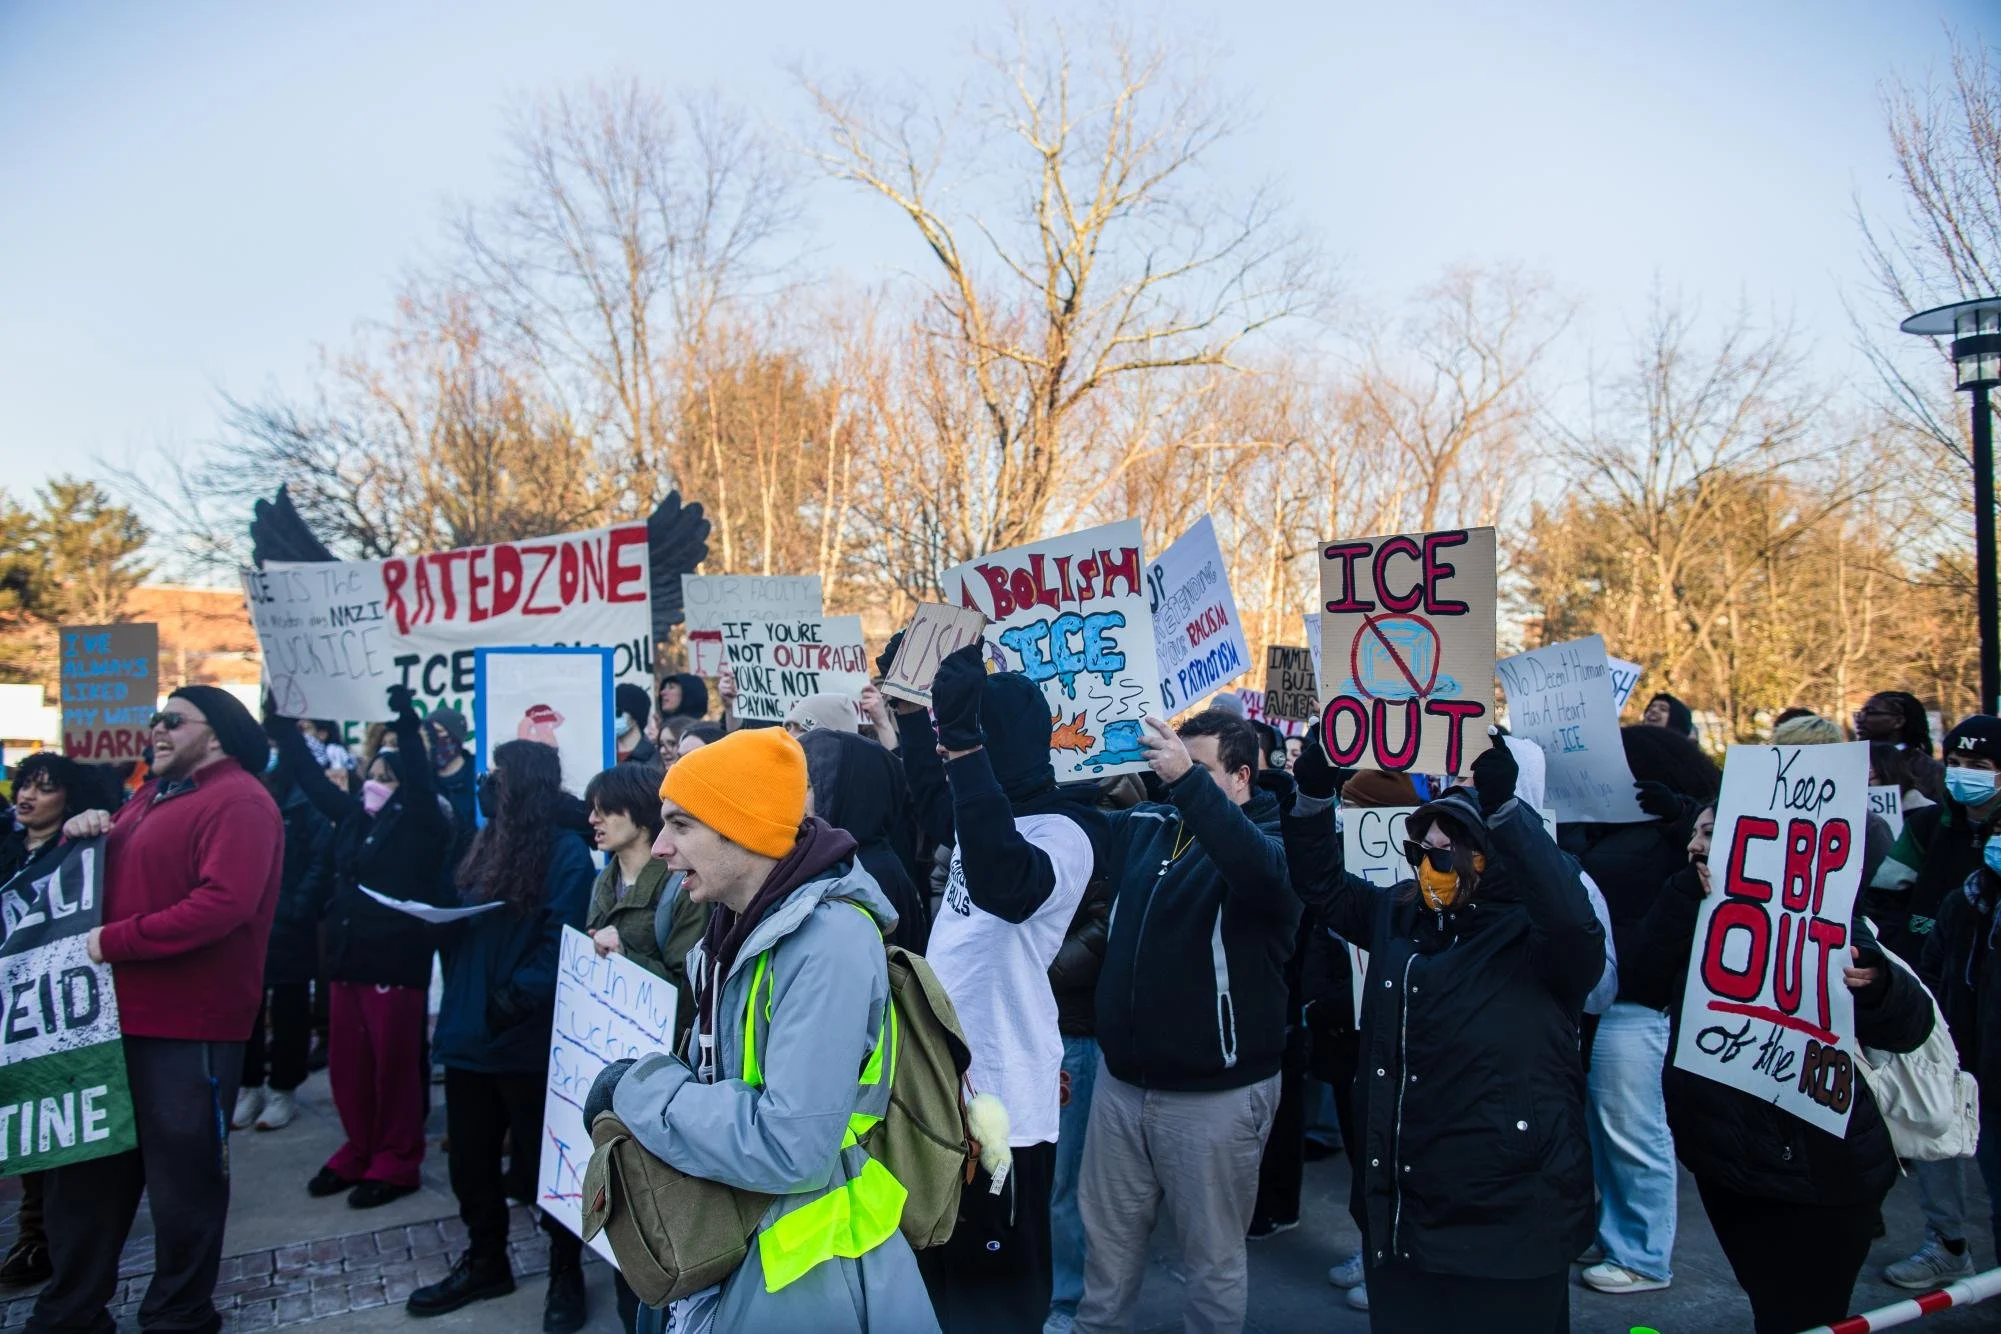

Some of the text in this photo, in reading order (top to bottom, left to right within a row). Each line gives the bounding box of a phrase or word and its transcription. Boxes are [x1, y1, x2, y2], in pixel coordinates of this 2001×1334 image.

[687, 578, 742, 606] OUR
[961, 547, 1142, 625] ABOLISH
[1324, 530, 1469, 615] ICE
[329, 600, 385, 628] NAZI
[722, 622, 752, 640] IF
[1186, 600, 1229, 649] RACISM
[727, 643, 765, 664] NOT
[773, 644, 868, 674] OUTRAGED
[999, 610, 1127, 686] ICE
[1500, 648, 1606, 696] No Decent Human
[63, 681, 129, 702] LIKED
[781, 671, 820, 697] NOT
[1160, 637, 1241, 710] IS PATRIOTISM
[1609, 667, 1638, 706] SH
[63, 708, 98, 727] MY
[737, 693, 784, 719] PAYING
[1522, 692, 1586, 727] Has A Heart
[1322, 695, 1486, 777] OUT
[1559, 725, 1588, 753] ICE
[1769, 746, 1836, 819] Keep
[1868, 791, 1898, 815] SH
[1724, 815, 1851, 916] CBP
[562, 932, 668, 1044] Not In My
[1700, 898, 1848, 1031] OUT
[0, 964, 100, 1043] EID
[1695, 1018, 1757, 1063] of
[1752, 1022, 1797, 1083] the
